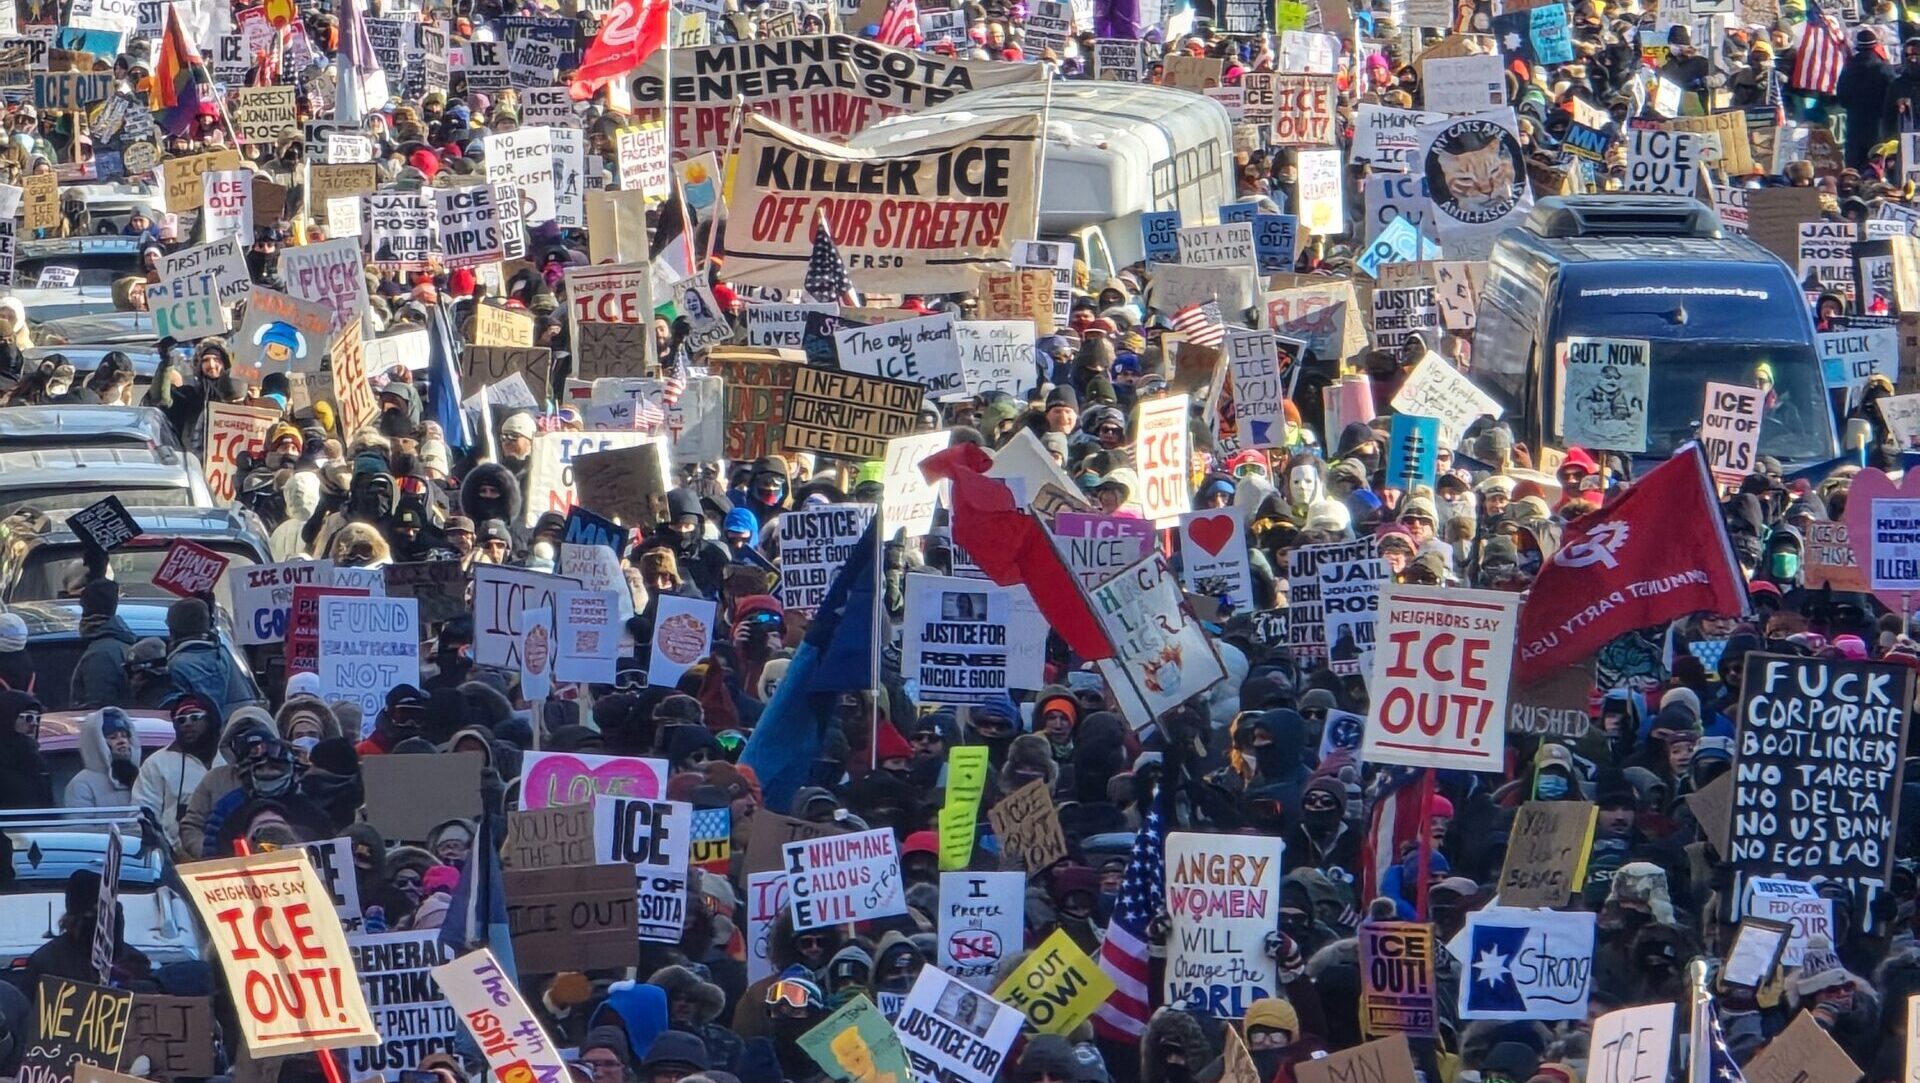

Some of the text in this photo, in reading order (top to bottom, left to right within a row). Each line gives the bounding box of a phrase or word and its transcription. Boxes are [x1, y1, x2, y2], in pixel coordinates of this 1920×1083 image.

[220, 35, 242, 61] ICE
[472, 42, 498, 66] ICE
[515, 51, 556, 69] TROOPS
[527, 44, 549, 52] NO
[696, 35, 972, 90] MINNESOTA
[34, 74, 111, 108] ICE OUT
[632, 62, 855, 102] GENERAL
[242, 91, 294, 106] ARREST
[530, 93, 563, 105] ICE
[1280, 88, 1326, 113] ICE
[243, 108, 295, 122] JONATHAN
[526, 108, 547, 116] OUT
[496, 136, 513, 149] NO
[622, 131, 662, 147] FIGHT
[1434, 121, 1506, 152] MY CATS ARE
[1635, 131, 1690, 162] ICE
[505, 144, 550, 160] MERCY
[177, 157, 216, 176] ICE
[490, 164, 513, 175] FOR
[756, 147, 1009, 198] KILLER ICE
[1633, 163, 1691, 186] OUT
[212, 181, 242, 194] ICE
[209, 196, 244, 208] OUT
[374, 196, 427, 209] JAIL
[446, 192, 489, 209] ICE
[374, 218, 428, 229] ROSS
[442, 210, 495, 225] OUT OF
[753, 195, 1008, 249] OFF OUR STREETS!
[1150, 219, 1175, 231] ICE
[1264, 223, 1291, 234] ICE
[393, 235, 428, 250] KILLER
[446, 228, 498, 255] MPLS
[1149, 233, 1178, 245] OUT
[1260, 235, 1291, 247] OUT
[1802, 225, 1855, 238] JAIL
[167, 243, 233, 273] FIRST THEY
[850, 254, 903, 268] FRSO
[299, 262, 359, 298] FUCK
[1376, 288, 1434, 309] JUSTICE
[1581, 287, 1768, 299] ImmigrantDefenseNetwork.org
[157, 302, 214, 336] ICE!
[576, 292, 638, 323] ICE
[751, 330, 801, 344] LOVES
[845, 320, 952, 355] The only decent
[1235, 336, 1272, 357] EFF
[1825, 336, 1869, 353] FUCK
[468, 350, 548, 379] FUCK
[877, 353, 918, 378] ICE
[1570, 343, 1645, 366] OUT. NOW.
[1236, 360, 1273, 378] ICE
[1853, 361, 1879, 377] ICE
[804, 369, 922, 411] INFLATION
[1236, 379, 1277, 400] YOU
[1713, 391, 1755, 415] ICE
[793, 398, 914, 433] CORRUPTION
[1707, 414, 1758, 432] OUT OF
[795, 431, 888, 457] ICE OUT
[1144, 434, 1180, 470] ICE
[781, 511, 857, 539] JUSTICE
[783, 550, 821, 565] RENEE
[1071, 539, 1125, 567] NICE
[249, 567, 314, 588] ICE OUT
[337, 572, 363, 587] NO
[783, 568, 827, 585] KILLED
[1323, 562, 1389, 583] JAIL
[784, 587, 827, 606] BY ICE
[329, 602, 408, 632] FUND
[1390, 610, 1500, 632] NEIGHBORS SAY
[921, 624, 1006, 645] JUSTICE FOR
[921, 652, 1006, 666] RENEE
[1386, 630, 1490, 690] ICE
[336, 664, 398, 688] NOT
[920, 667, 1005, 688] NICOLE GOOD
[1765, 661, 1890, 705] FUCK
[1379, 687, 1494, 746] OUT!
[1748, 695, 1902, 736] CORPORATE
[1737, 763, 1891, 790] NO TARGET
[1737, 788, 1879, 815] NO DELTA
[513, 812, 586, 842] YOU PUT
[612, 800, 672, 866] ICE
[1737, 814, 1891, 841] NO US BANK
[1732, 838, 1880, 867] NO ECOLAB
[794, 865, 871, 897] CALLOUS
[1174, 853, 1268, 886] ANGRY
[204, 881, 308, 904] NEIGHBORS SAY
[656, 878, 684, 893] OF
[969, 879, 989, 897] I
[1759, 881, 1810, 895] JUSTICE
[572, 898, 634, 930] OUT
[799, 895, 857, 927] EVIL
[952, 904, 1002, 917] PREFER
[1170, 886, 1268, 922] WOMEN
[1770, 901, 1788, 914] FED
[217, 903, 327, 960] ICE
[1181, 928, 1243, 952] WILL
[350, 941, 451, 971] GENERAL
[951, 936, 998, 960] ICE
[1371, 935, 1426, 958] ICE
[1026, 949, 1065, 989] OUT
[1232, 959, 1263, 983] the
[1372, 959, 1427, 993] OUT!
[473, 957, 510, 1006] The
[245, 968, 345, 1022] OUT!
[40, 982, 128, 1054] WE ARE
[388, 1006, 456, 1034] PATH TO
[900, 1007, 968, 1060] JUSTICE
[970, 1037, 1001, 1075] FOR
[1603, 1027, 1653, 1081] ICE
